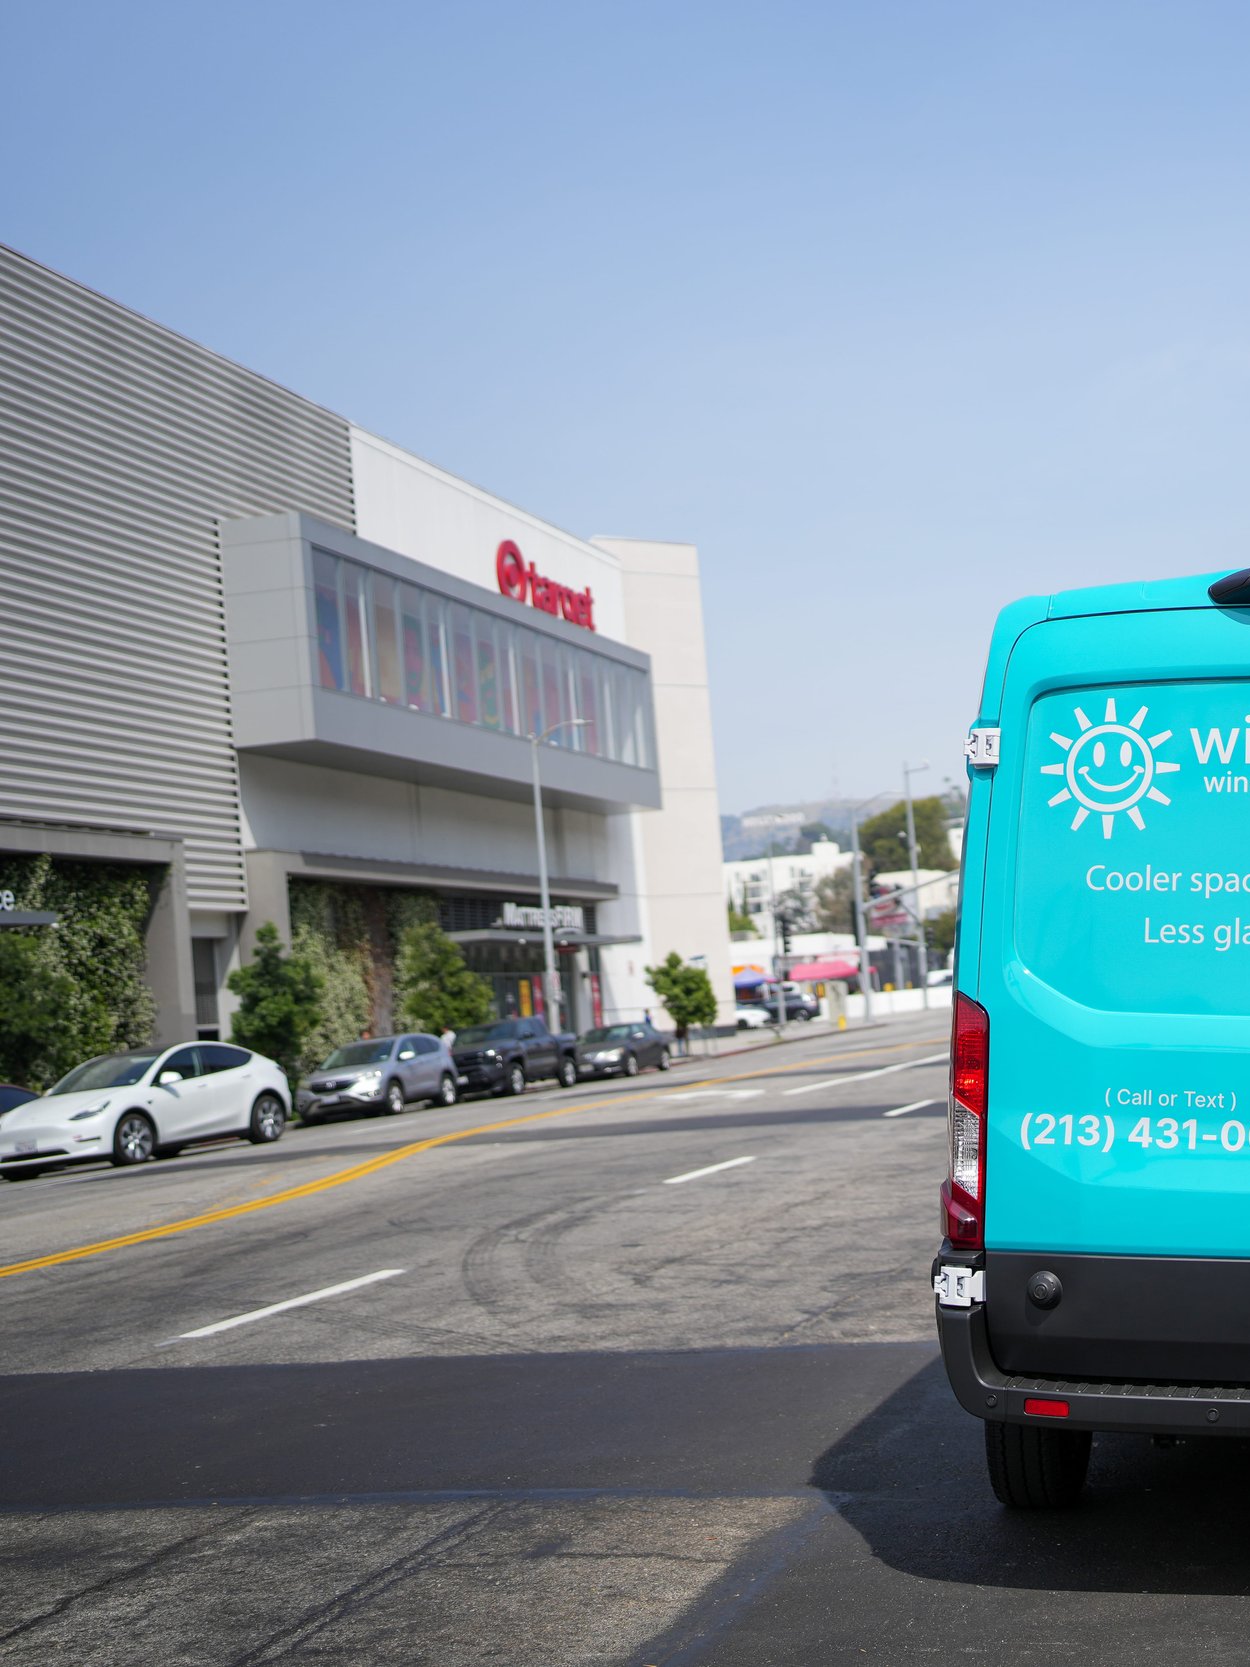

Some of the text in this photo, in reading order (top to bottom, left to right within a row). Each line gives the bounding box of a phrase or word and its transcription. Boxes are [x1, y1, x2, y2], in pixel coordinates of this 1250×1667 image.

[1085, 864, 1183, 893] Cooler
[1144, 917, 1205, 945] Less
[1117, 1088, 1153, 1106] Call
[1158, 1093, 1179, 1107] or
[1183, 1090, 1225, 1109] Text
[1020, 1112, 1116, 1154] (213)
